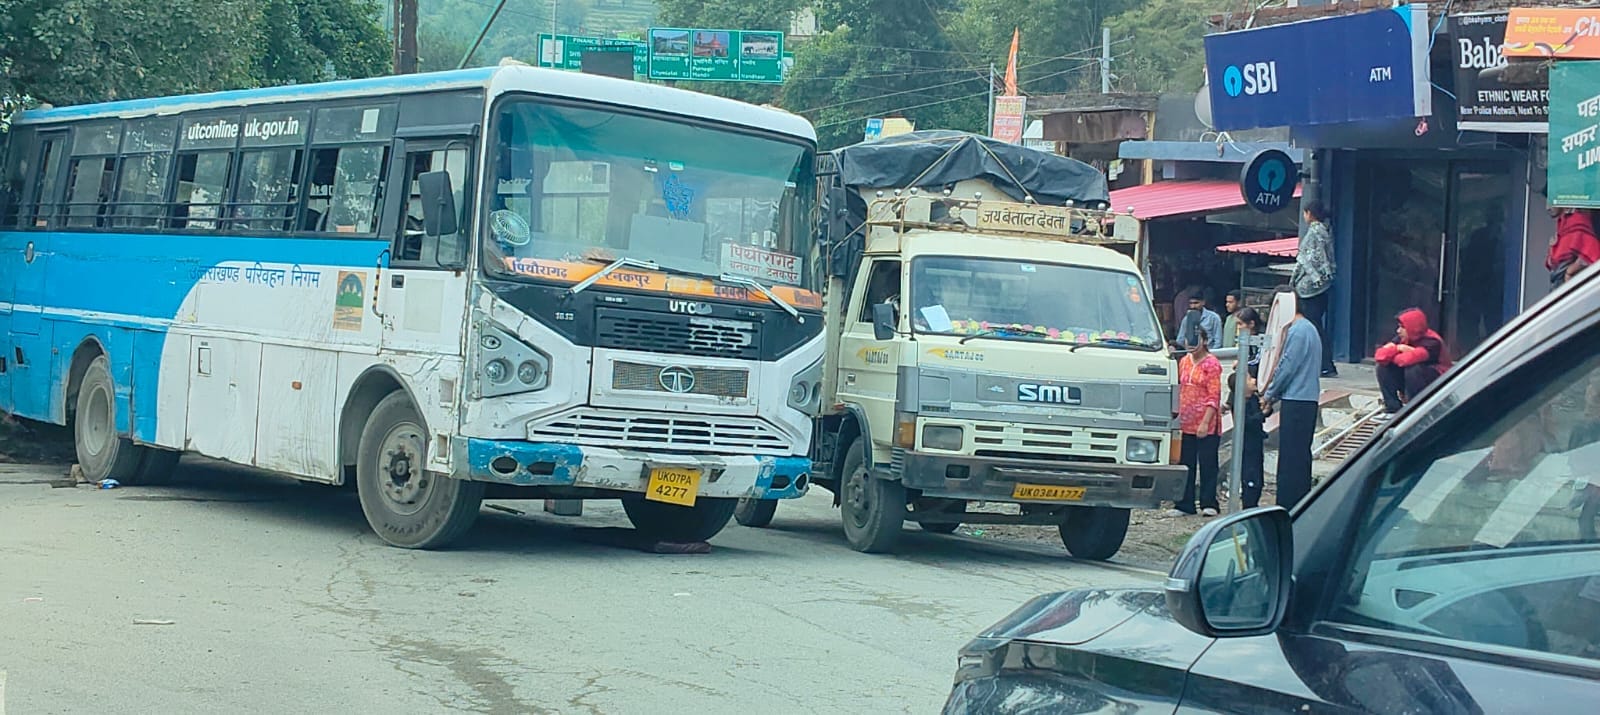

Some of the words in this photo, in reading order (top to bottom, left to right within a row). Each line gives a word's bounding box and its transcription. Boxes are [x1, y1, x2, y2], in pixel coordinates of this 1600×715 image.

[1243, 61, 1278, 96] SBI
[1369, 66, 1392, 83] ATM
[1477, 90, 1511, 102] ETHNIC
[1511, 90, 1540, 102] WEAR
[1474, 105, 1492, 115] Police
[1518, 106, 1533, 116] Next
[1534, 106, 1542, 115] To
[1561, 124, 1598, 153] सफर
[1255, 192, 1281, 206] ATM
[982, 210, 1001, 223] जय
[1002, 208, 1036, 226] बेताल
[1037, 209, 1066, 229] देवता
[245, 261, 286, 288] परिवहन
[290, 263, 321, 288] निगम
[1018, 384, 1081, 404] SML
[657, 471, 692, 485] UK07PA
[656, 484, 688, 499] 4277
